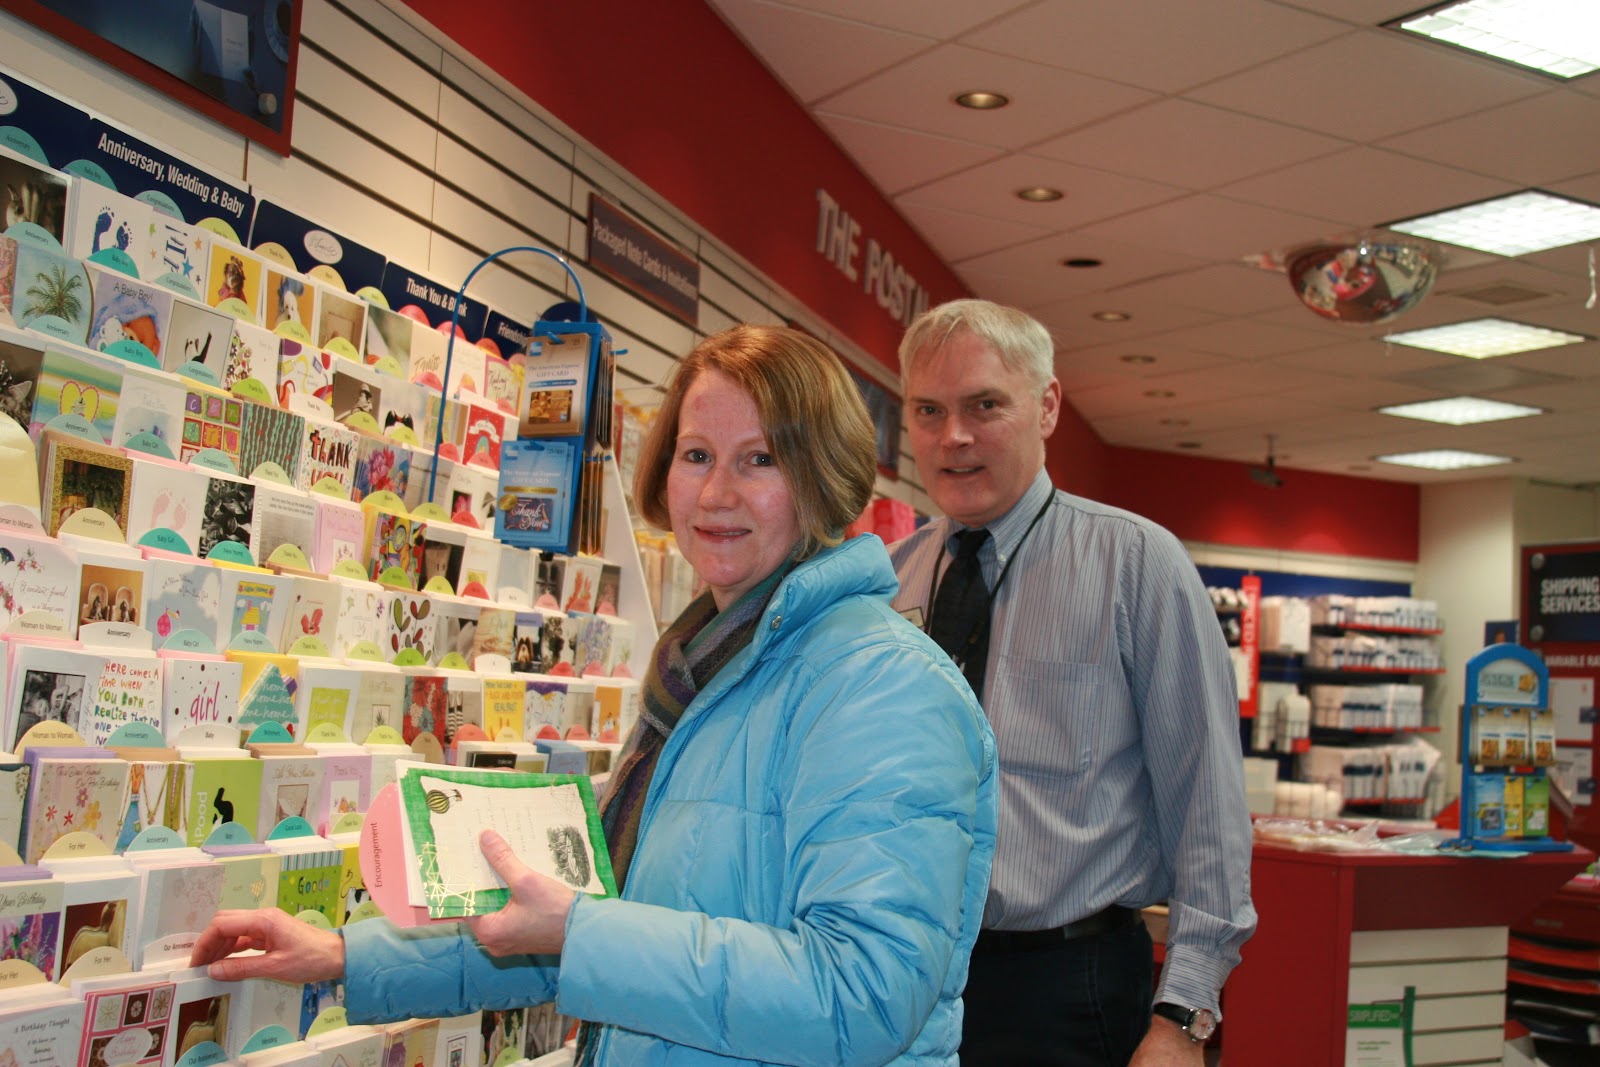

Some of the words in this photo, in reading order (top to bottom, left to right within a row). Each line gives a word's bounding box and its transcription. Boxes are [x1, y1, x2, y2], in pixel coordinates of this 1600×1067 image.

[98, 132, 165, 183] Anniversary,
[167, 165, 210, 203] Wedding
[211, 188, 220, 205] &
[221, 190, 244, 218] Baby
[816, 188, 862, 283] THE
[863, 238, 929, 327] POST
[114, 282, 120, 292] A
[121, 284, 137, 299] Baby
[406, 277, 428, 300] Thank
[428, 288, 442, 308] You
[442, 295, 447, 308] &
[449, 295, 468, 317] Blnk
[65, 422, 89, 433] Anniversary
[511, 502, 541, 517] Thank
[0, 516, 12, 526] oman
[17, 519, 34, 529] Woman
[82, 516, 105, 528] Anniversary
[520, 515, 543, 530] You
[157, 534, 166, 544] Baby
[1541, 576, 1600, 596] SHIPPING
[1541, 595, 1600, 614] SERVICES
[21, 621, 38, 629] Woman
[45, 623, 63, 631] Woman
[107, 628, 131, 638] Anniversary
[183, 639, 192, 648] Baby
[100, 676, 116, 688] ime
[190, 681, 220, 725] girl
[32, 731, 50, 739] Woman
[124, 731, 149, 741] Anniversary
[205, 731, 214, 739] Baby
[146, 836, 169, 844] Anniversary
[371, 822, 382, 888] Encouragement
[17, 892, 47, 911] Birthday
[94, 956, 103, 964] For
[0, 972, 8, 981] For
[19, 1022, 48, 1034] Birthday
[48, 1018, 70, 1029] Thought
[262, 1036, 278, 1045] Wedding
[189, 1057, 197, 1065] Our
[197, 1052, 219, 1064] Anniversary
